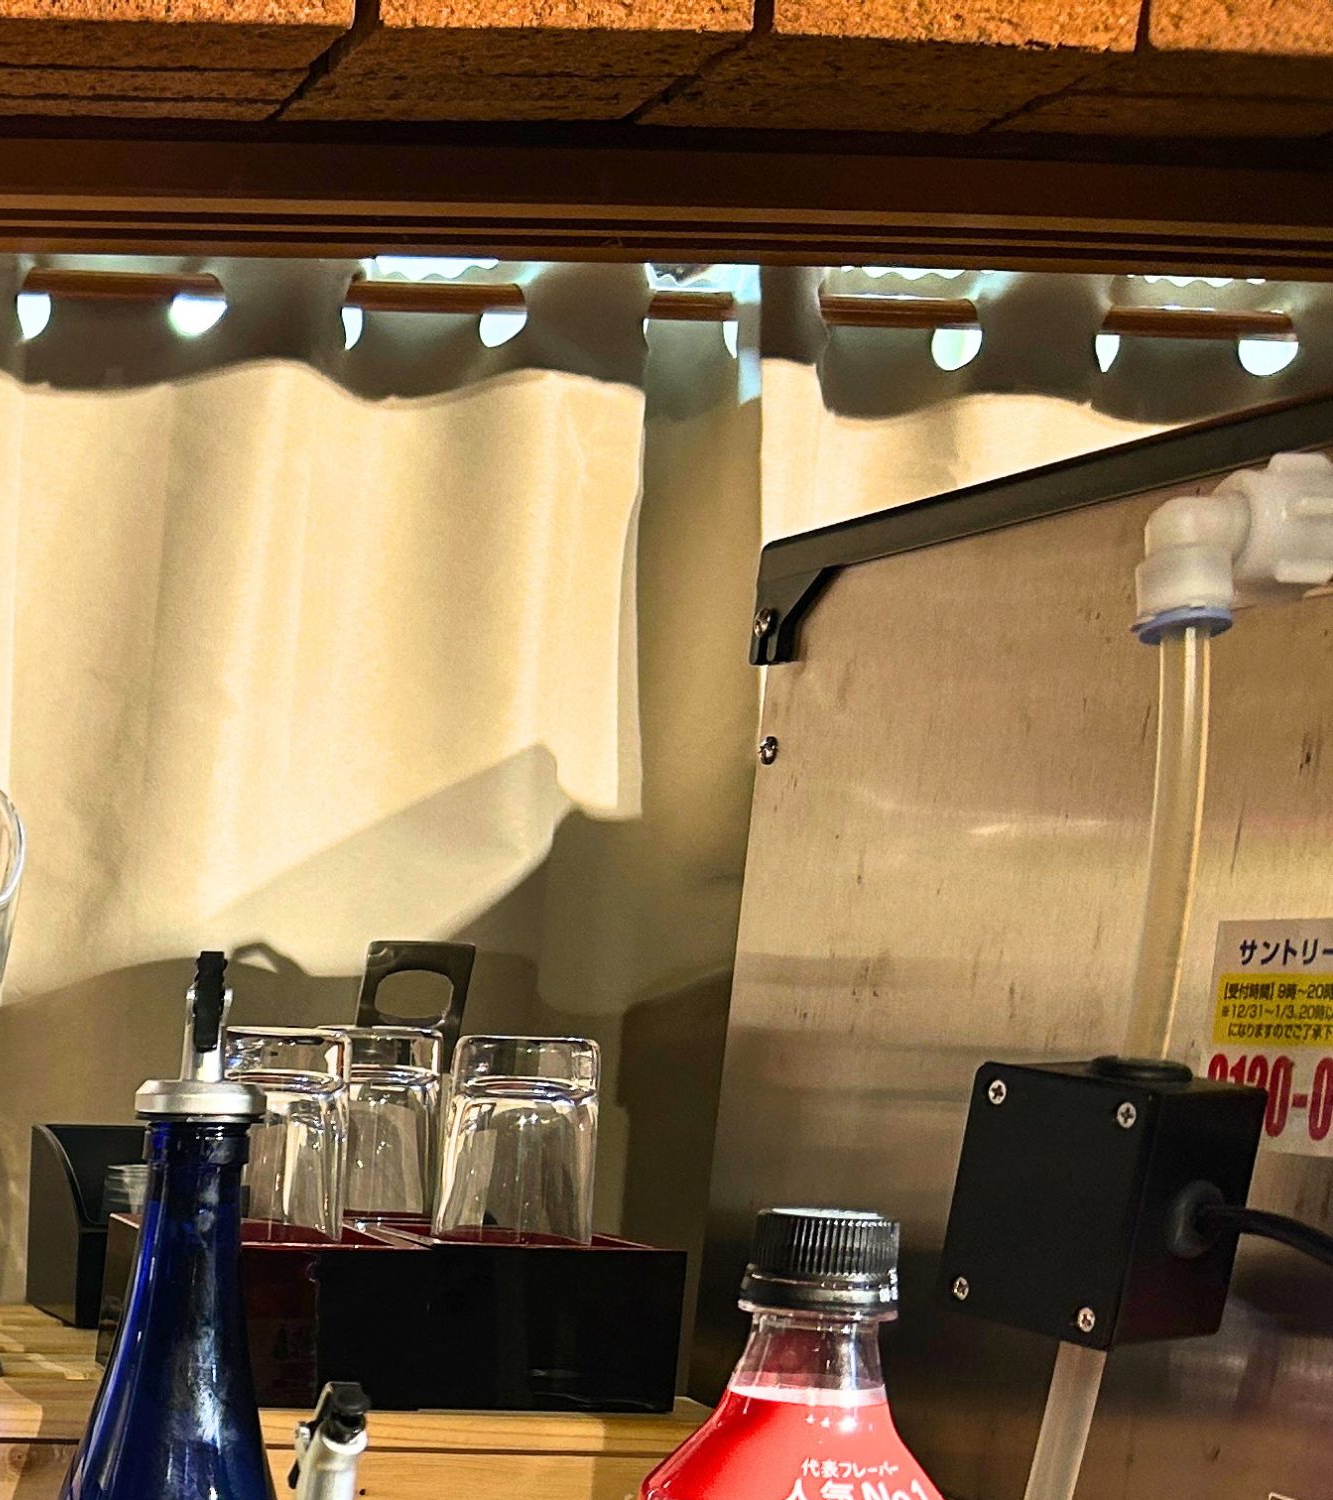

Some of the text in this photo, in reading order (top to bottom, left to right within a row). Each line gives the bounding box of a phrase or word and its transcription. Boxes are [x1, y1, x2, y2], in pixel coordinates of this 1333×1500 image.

[801, 1457, 900, 1479] 代表フレーバー
